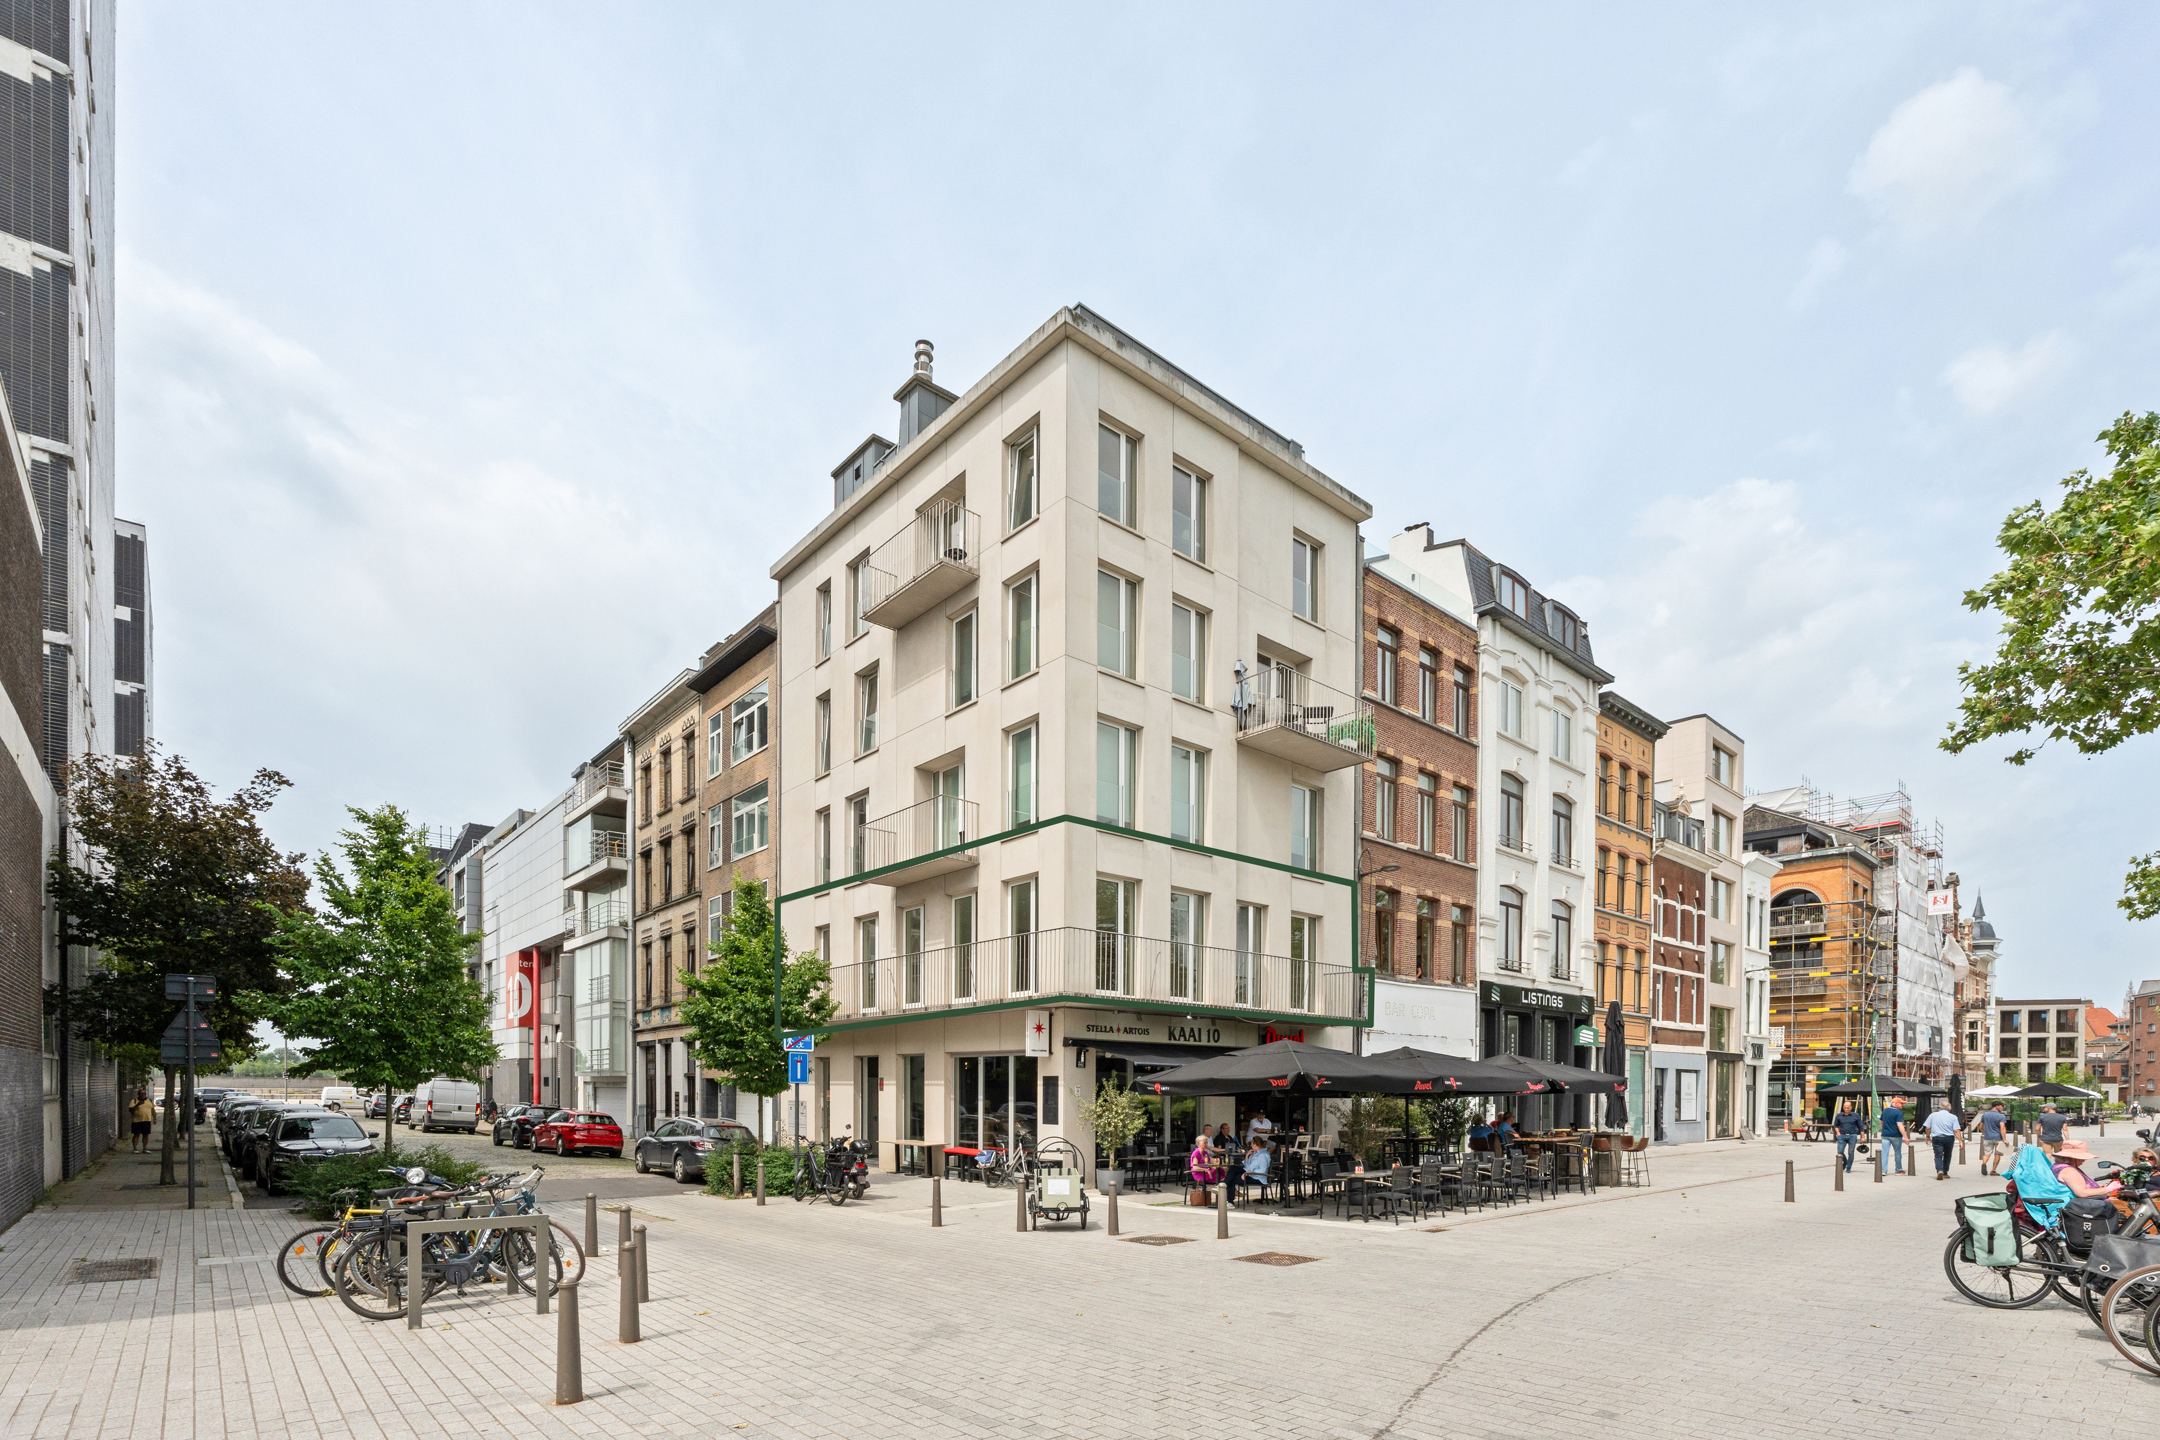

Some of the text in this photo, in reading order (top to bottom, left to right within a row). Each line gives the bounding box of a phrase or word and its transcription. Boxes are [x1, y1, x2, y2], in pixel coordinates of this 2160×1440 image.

[1521, 990, 1564, 1008] LISTINGS
[1384, 1001, 1436, 1021] BAR COPA
[1086, 1024, 1150, 1036] STELLA ARTOIS
[1167, 1025, 1220, 1043] KAAI 10
[1414, 1080, 1432, 1090] Duvel
